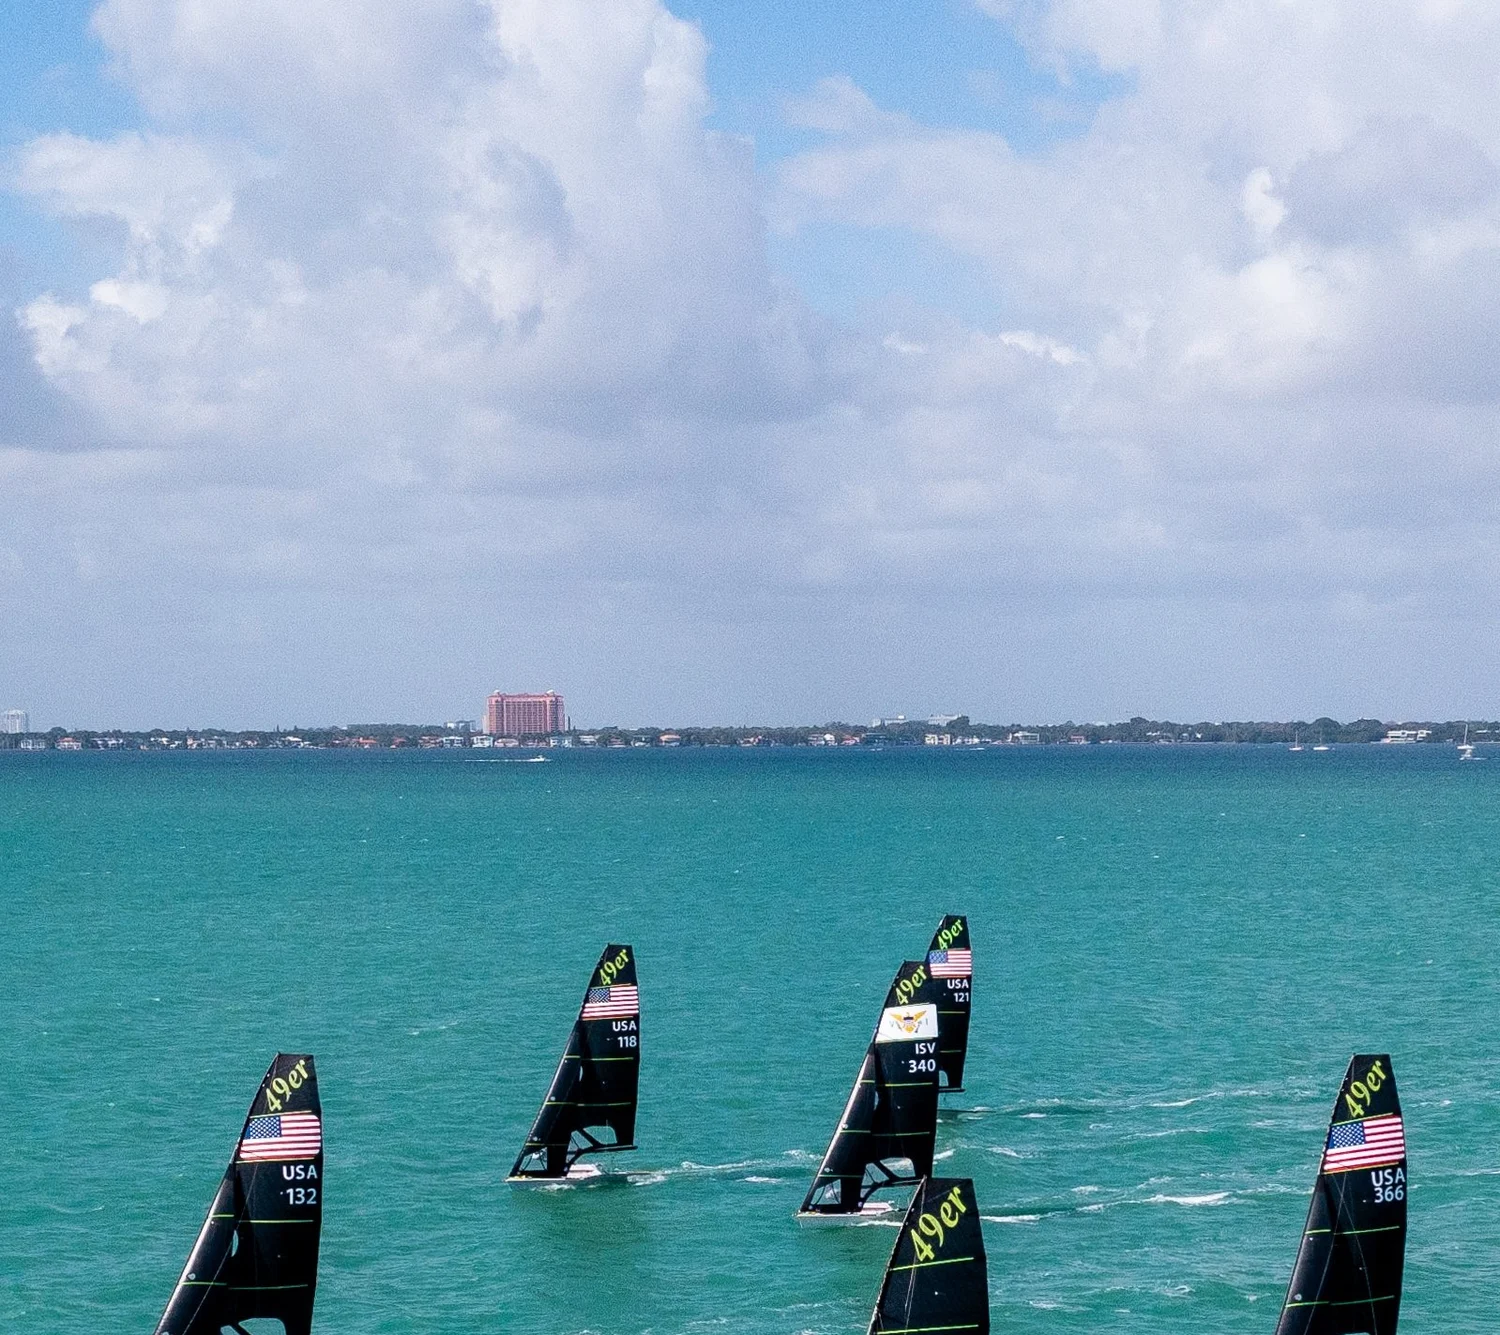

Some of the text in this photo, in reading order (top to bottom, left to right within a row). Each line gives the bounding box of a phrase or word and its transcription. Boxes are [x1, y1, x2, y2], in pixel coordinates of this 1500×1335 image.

[599, 949, 629, 985] 49er
[895, 965, 927, 1005] 49er
[947, 979, 969, 989] USA
[954, 992, 969, 1002] 121
[612, 1021, 637, 1032] USA
[618, 1036, 637, 1048] 118
[915, 1043, 935, 1054] ISV
[908, 1059, 936, 1073] 340
[266, 1059, 308, 1112] 49er
[1345, 1060, 1387, 1118] 49er
[282, 1165, 318, 1181] USA
[1371, 1168, 1405, 1187] USA
[286, 1188, 317, 1205] 132
[1375, 1186, 1403, 1203] 366
[910, 1187, 966, 1261] 49er
